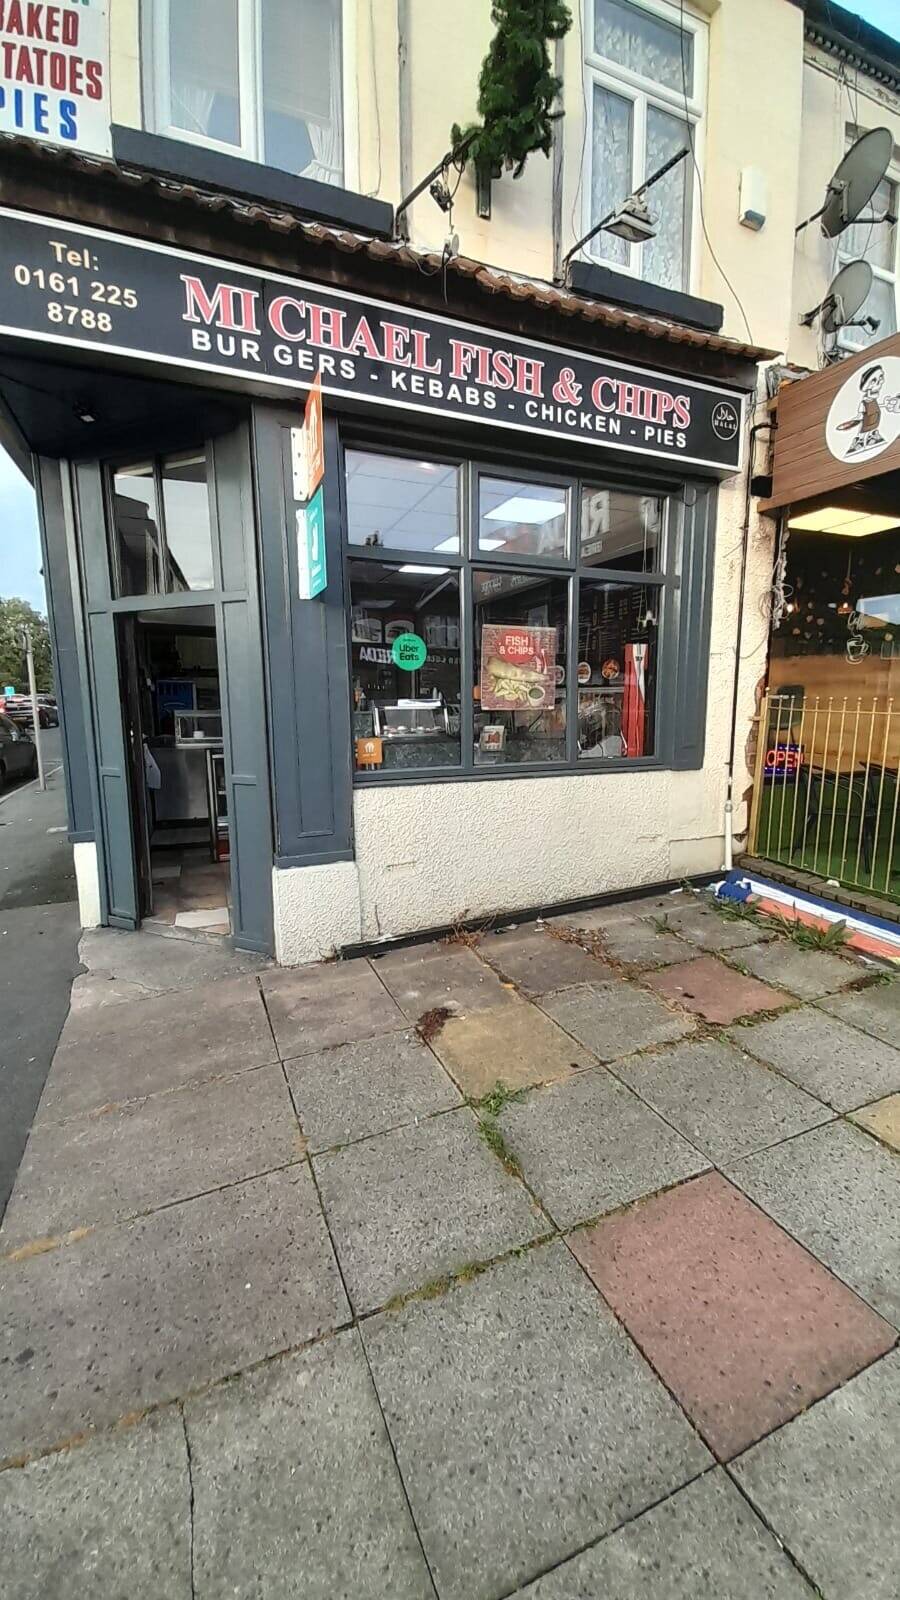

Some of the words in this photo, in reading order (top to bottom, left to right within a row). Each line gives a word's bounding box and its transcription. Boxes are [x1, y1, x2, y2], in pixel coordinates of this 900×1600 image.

[48, 240, 99, 271] Tel:
[14, 264, 79, 297] 0161
[90, 281, 138, 309] 225
[47, 301, 113, 332] 8788
[449, 339, 545, 398] FISH
[552, 367, 583, 407] &
[591, 376, 691, 430] CHIPS
[391, 370, 497, 410] KEBABS
[525, 400, 621, 435] CHICKEN
[644, 426, 687, 448] PIES
[714, 419, 736, 431] HALAL
[399, 643, 420, 653] Uber
[505, 635, 528, 647] FISH
[399, 652, 420, 661] Eats
[507, 646, 534, 656] CHIPS
[766, 749, 804, 768] OPEN
